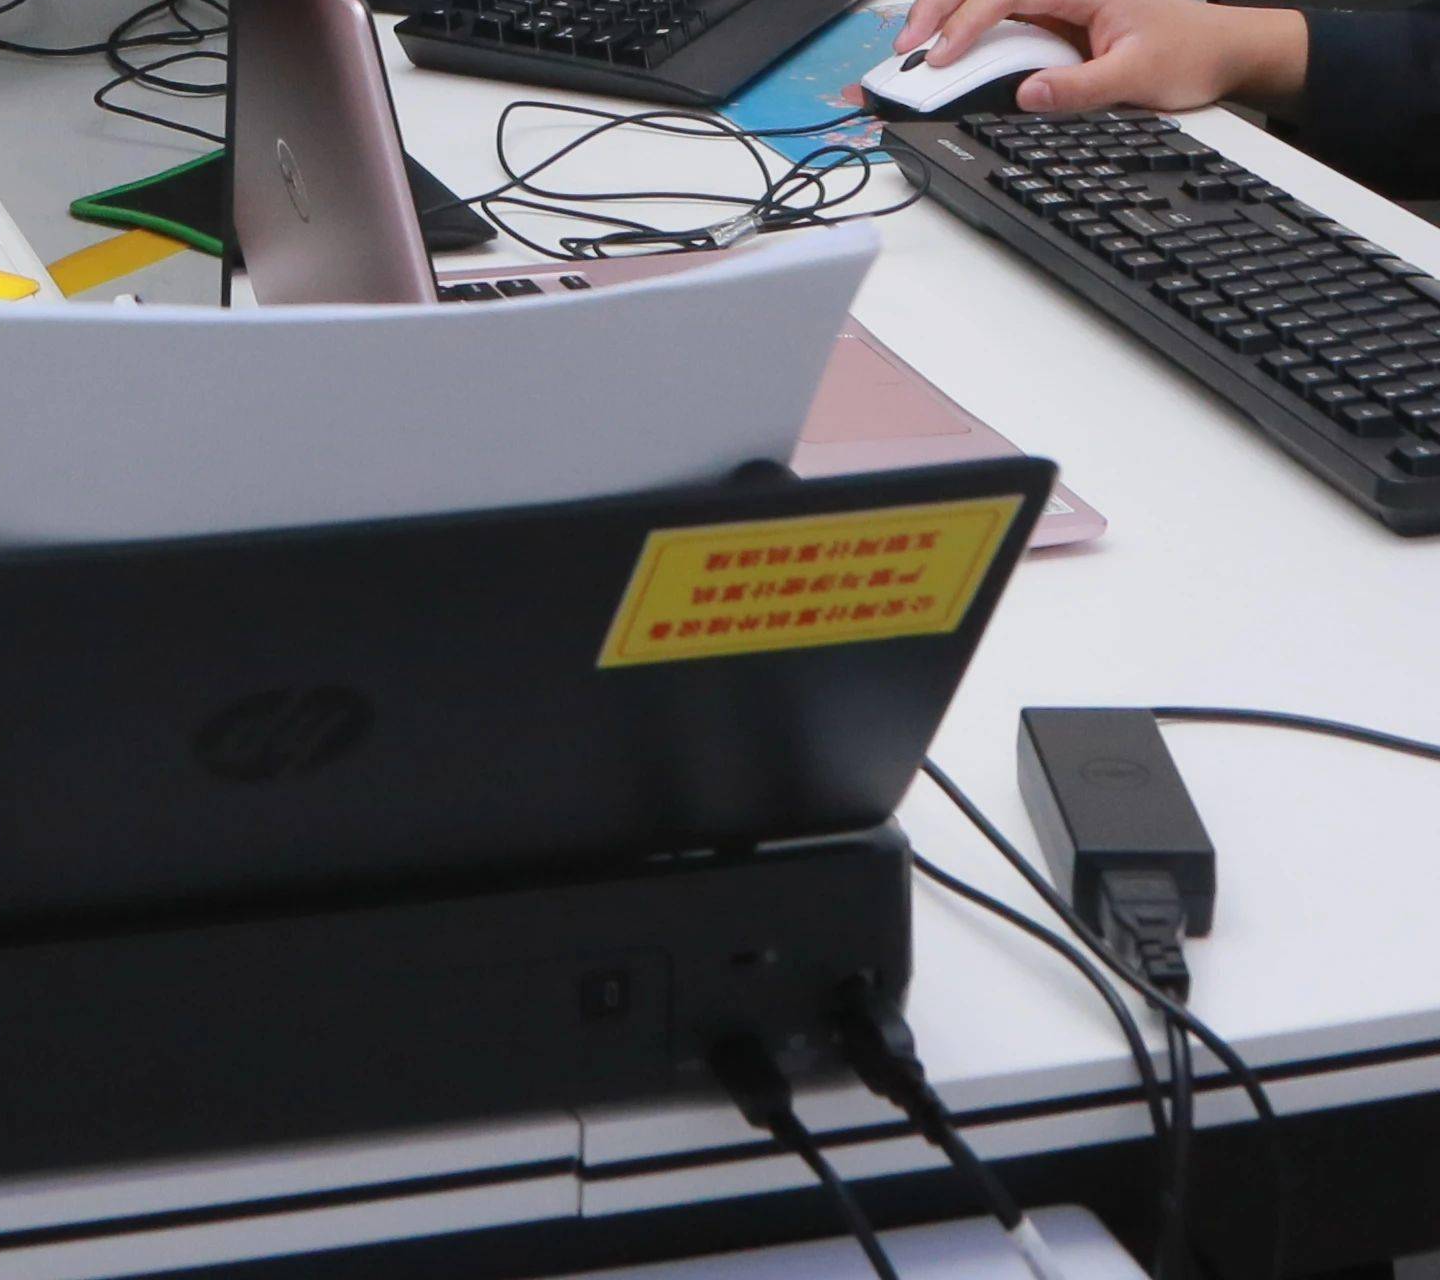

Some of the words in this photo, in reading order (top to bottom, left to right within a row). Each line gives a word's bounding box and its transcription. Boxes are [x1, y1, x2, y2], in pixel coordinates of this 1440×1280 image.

[705, 529, 941, 572] 互联网计算机连接
[691, 564, 928, 607] 严禁与涉密计算机
[649, 594, 937, 640] 公安网计算机外接设备
